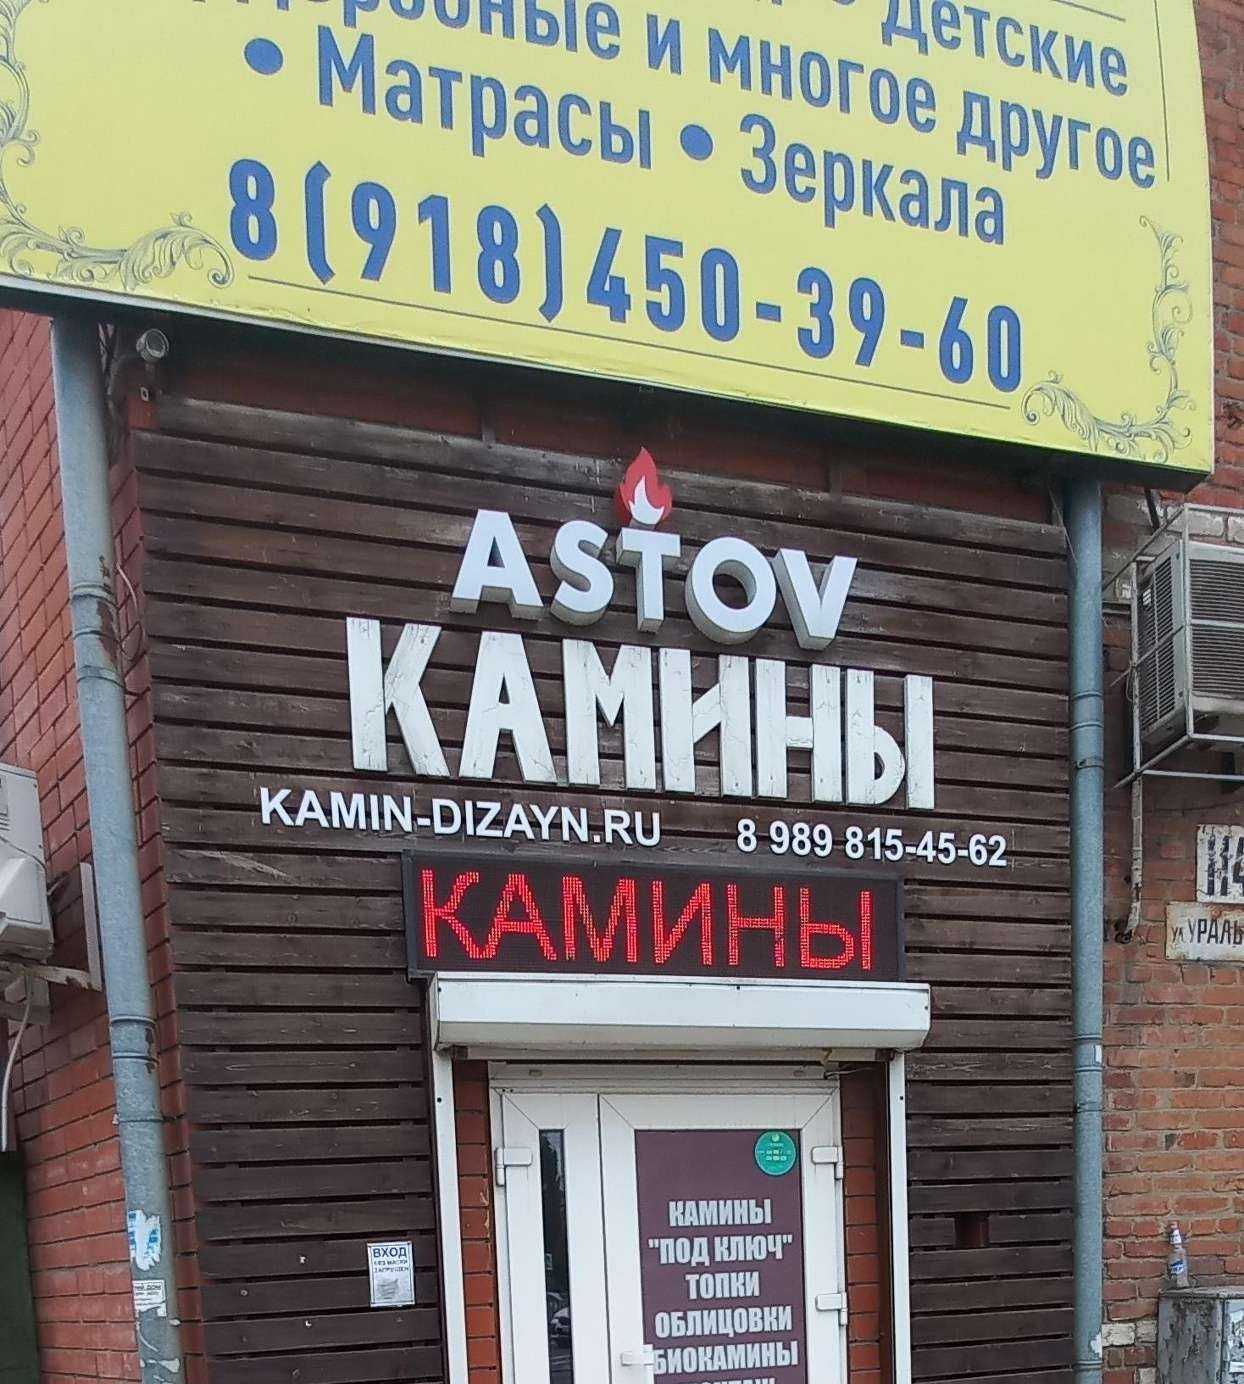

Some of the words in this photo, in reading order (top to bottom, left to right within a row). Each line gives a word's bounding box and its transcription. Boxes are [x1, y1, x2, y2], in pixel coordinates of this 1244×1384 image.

[647, 14, 683, 75] и
[708, 27, 936, 134] многое
[956, 90, 1155, 189] другое
[317, 25, 652, 168] Матрасы
[740, 113, 1004, 245] Зеркала
[228, 158, 1021, 392] 8(918)450-39-60
[450, 509, 858, 651] ASTOV
[346, 616, 935, 809] КАМИНЫ
[259, 787, 662, 847] KAMIN-DIZAYN.RU
[737, 818, 758, 853] 8
[769, 820, 834, 857] 989
[844, 824, 1008, 867] 815-45-62
[421, 869, 872, 971] КАМИНЫ
[668, 1199, 772, 1227] КАМИНЫ
[373, 1246, 408, 1259] ВХОД
[648, 1237, 711, 1266] "ПОД
[714, 1234, 793, 1263] КЛЮЧ"
[685, 1271, 760, 1300] ТОПКИ
[654, 1306, 793, 1338] ОБЛИЦОВКИ
[653, 1341, 798, 1375] БИОКАМИНЫ
